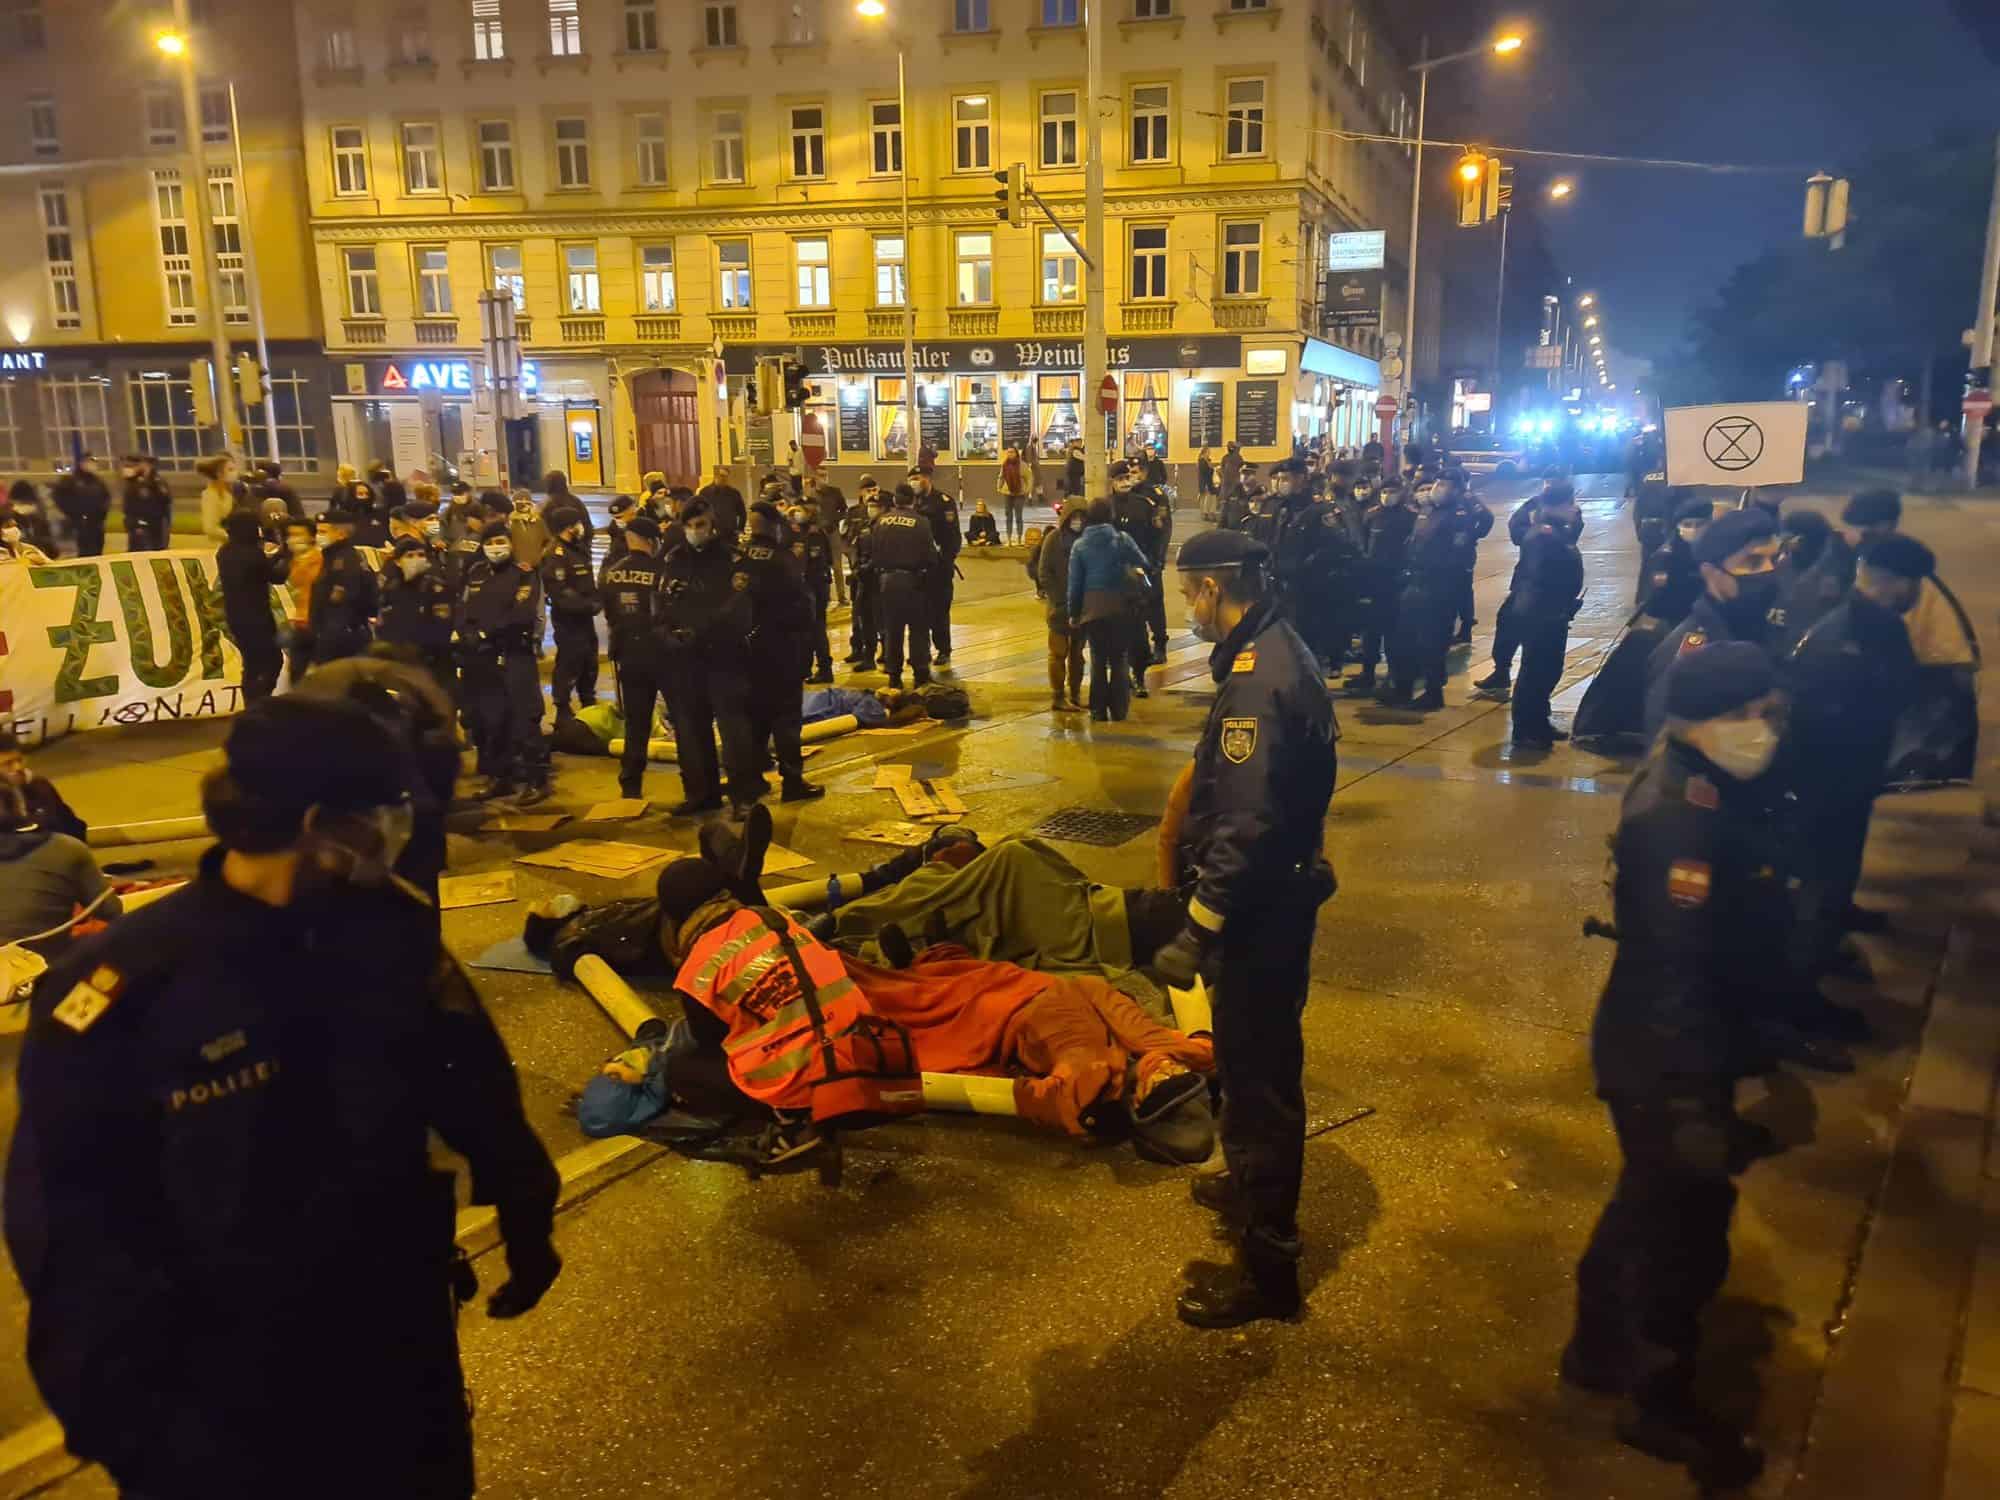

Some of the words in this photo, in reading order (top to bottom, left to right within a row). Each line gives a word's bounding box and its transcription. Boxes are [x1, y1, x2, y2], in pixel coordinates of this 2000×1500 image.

[820, 345, 951, 374] Pulkaualer
[1015, 342, 1131, 366] Weinus
[410, 361, 538, 390] AVES
[879, 513, 917, 529] POLIZEI
[605, 567, 655, 585] POLIZEI
